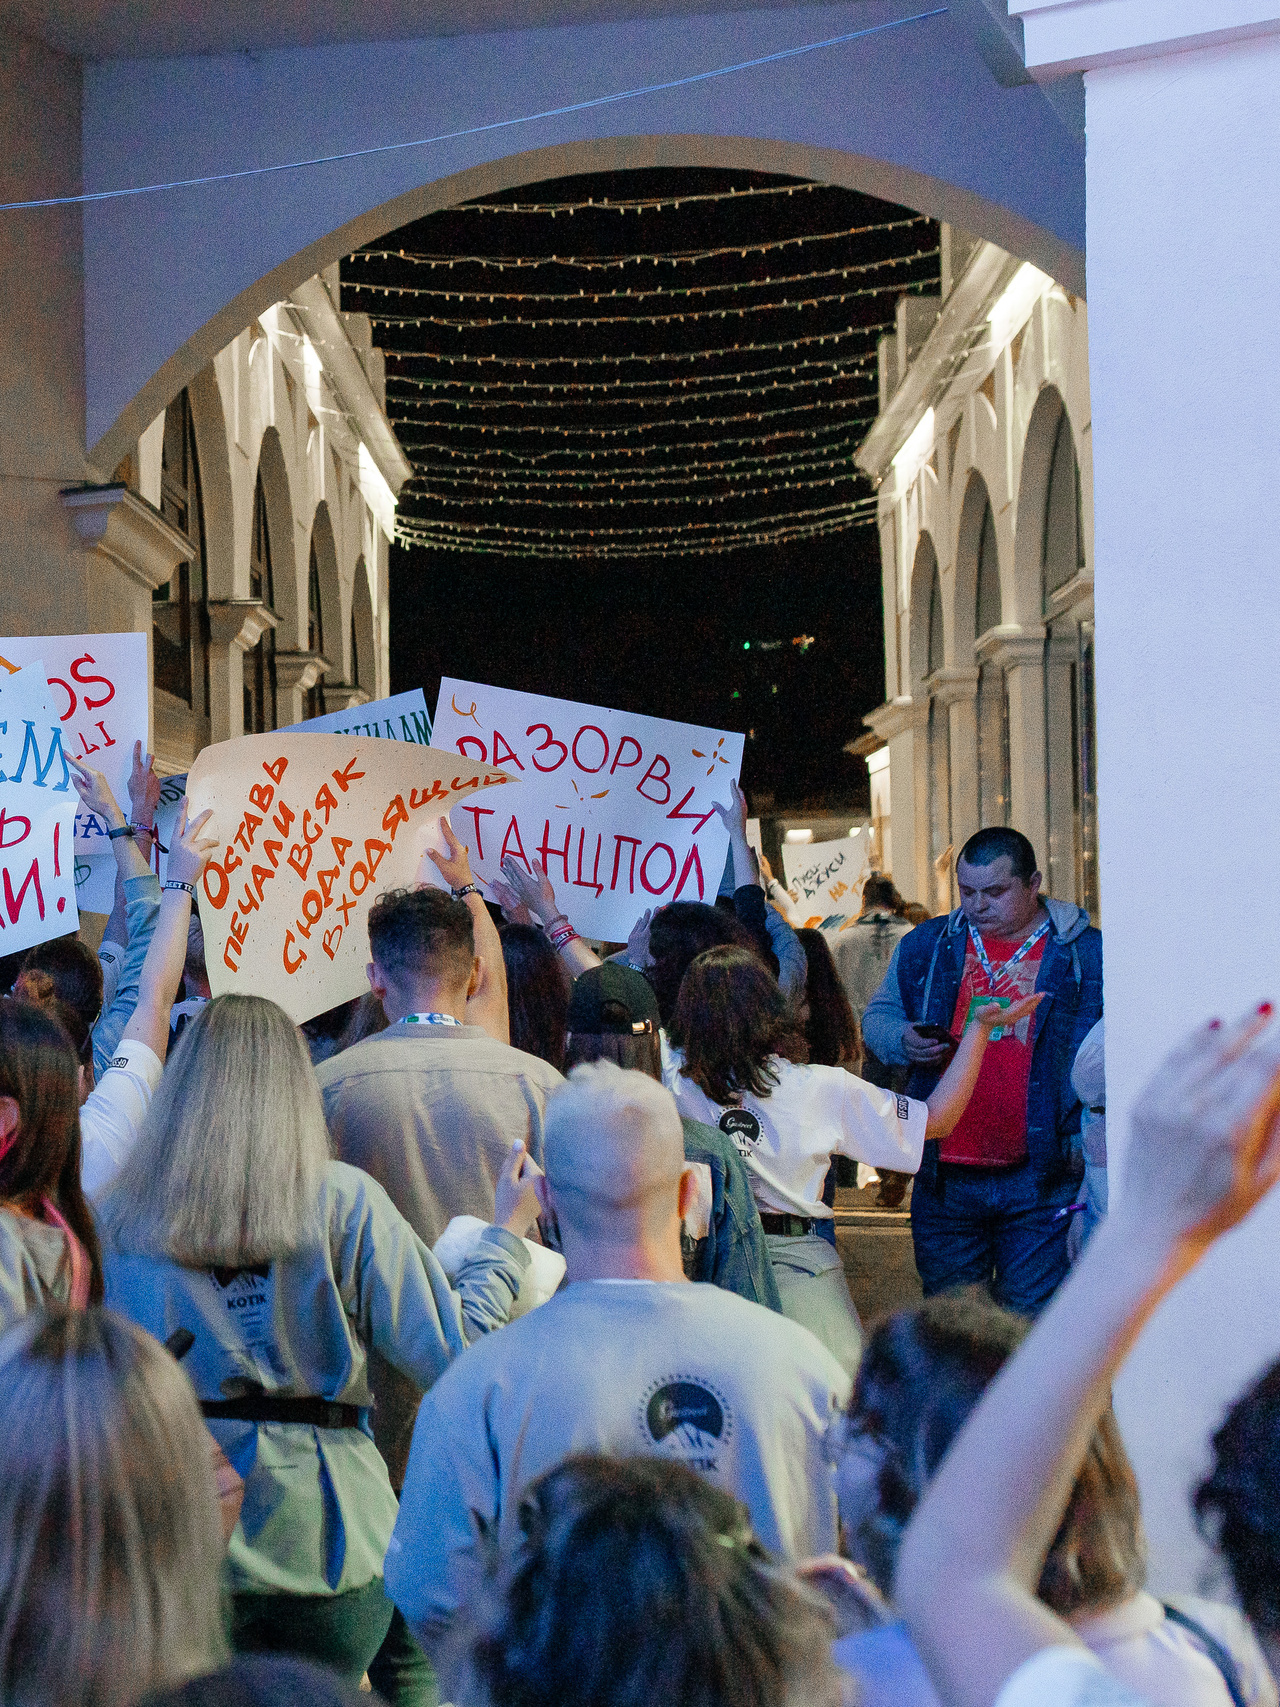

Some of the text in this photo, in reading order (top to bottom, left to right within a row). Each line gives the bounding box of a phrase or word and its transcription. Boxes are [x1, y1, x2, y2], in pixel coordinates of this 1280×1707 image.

[203, 756, 288, 910] ОСТАВЬ
[224, 800, 296, 973] ПЕЧАЛИ
[287, 757, 366, 881] ВСЯК
[461, 805, 705, 902] ТАНЦПОЛ
[283, 837, 353, 975] СЮДА
